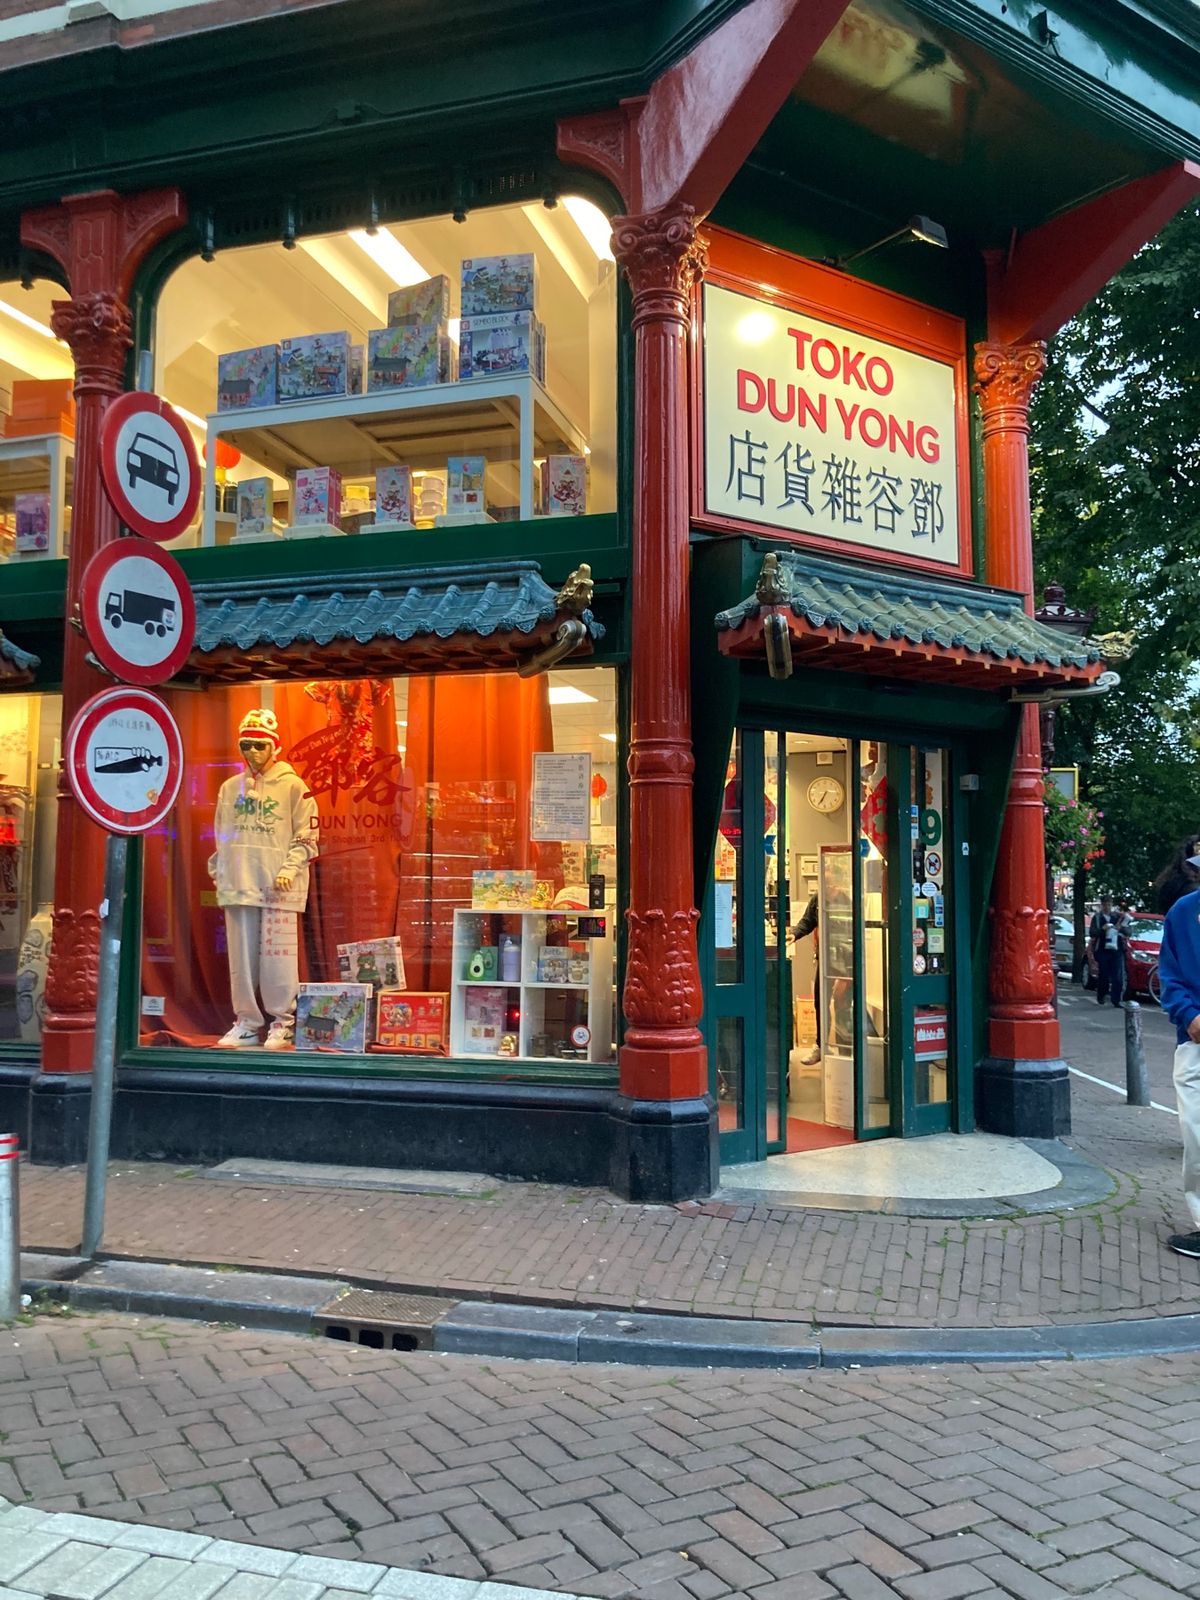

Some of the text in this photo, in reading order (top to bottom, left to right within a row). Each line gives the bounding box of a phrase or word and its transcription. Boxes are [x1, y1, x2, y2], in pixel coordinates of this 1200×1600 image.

[787, 327, 894, 396] TOKO
[737, 369, 940, 464] DUN YONG
[309, 813, 402, 829] DUN YONG
[920, 809, 942, 846] 9
